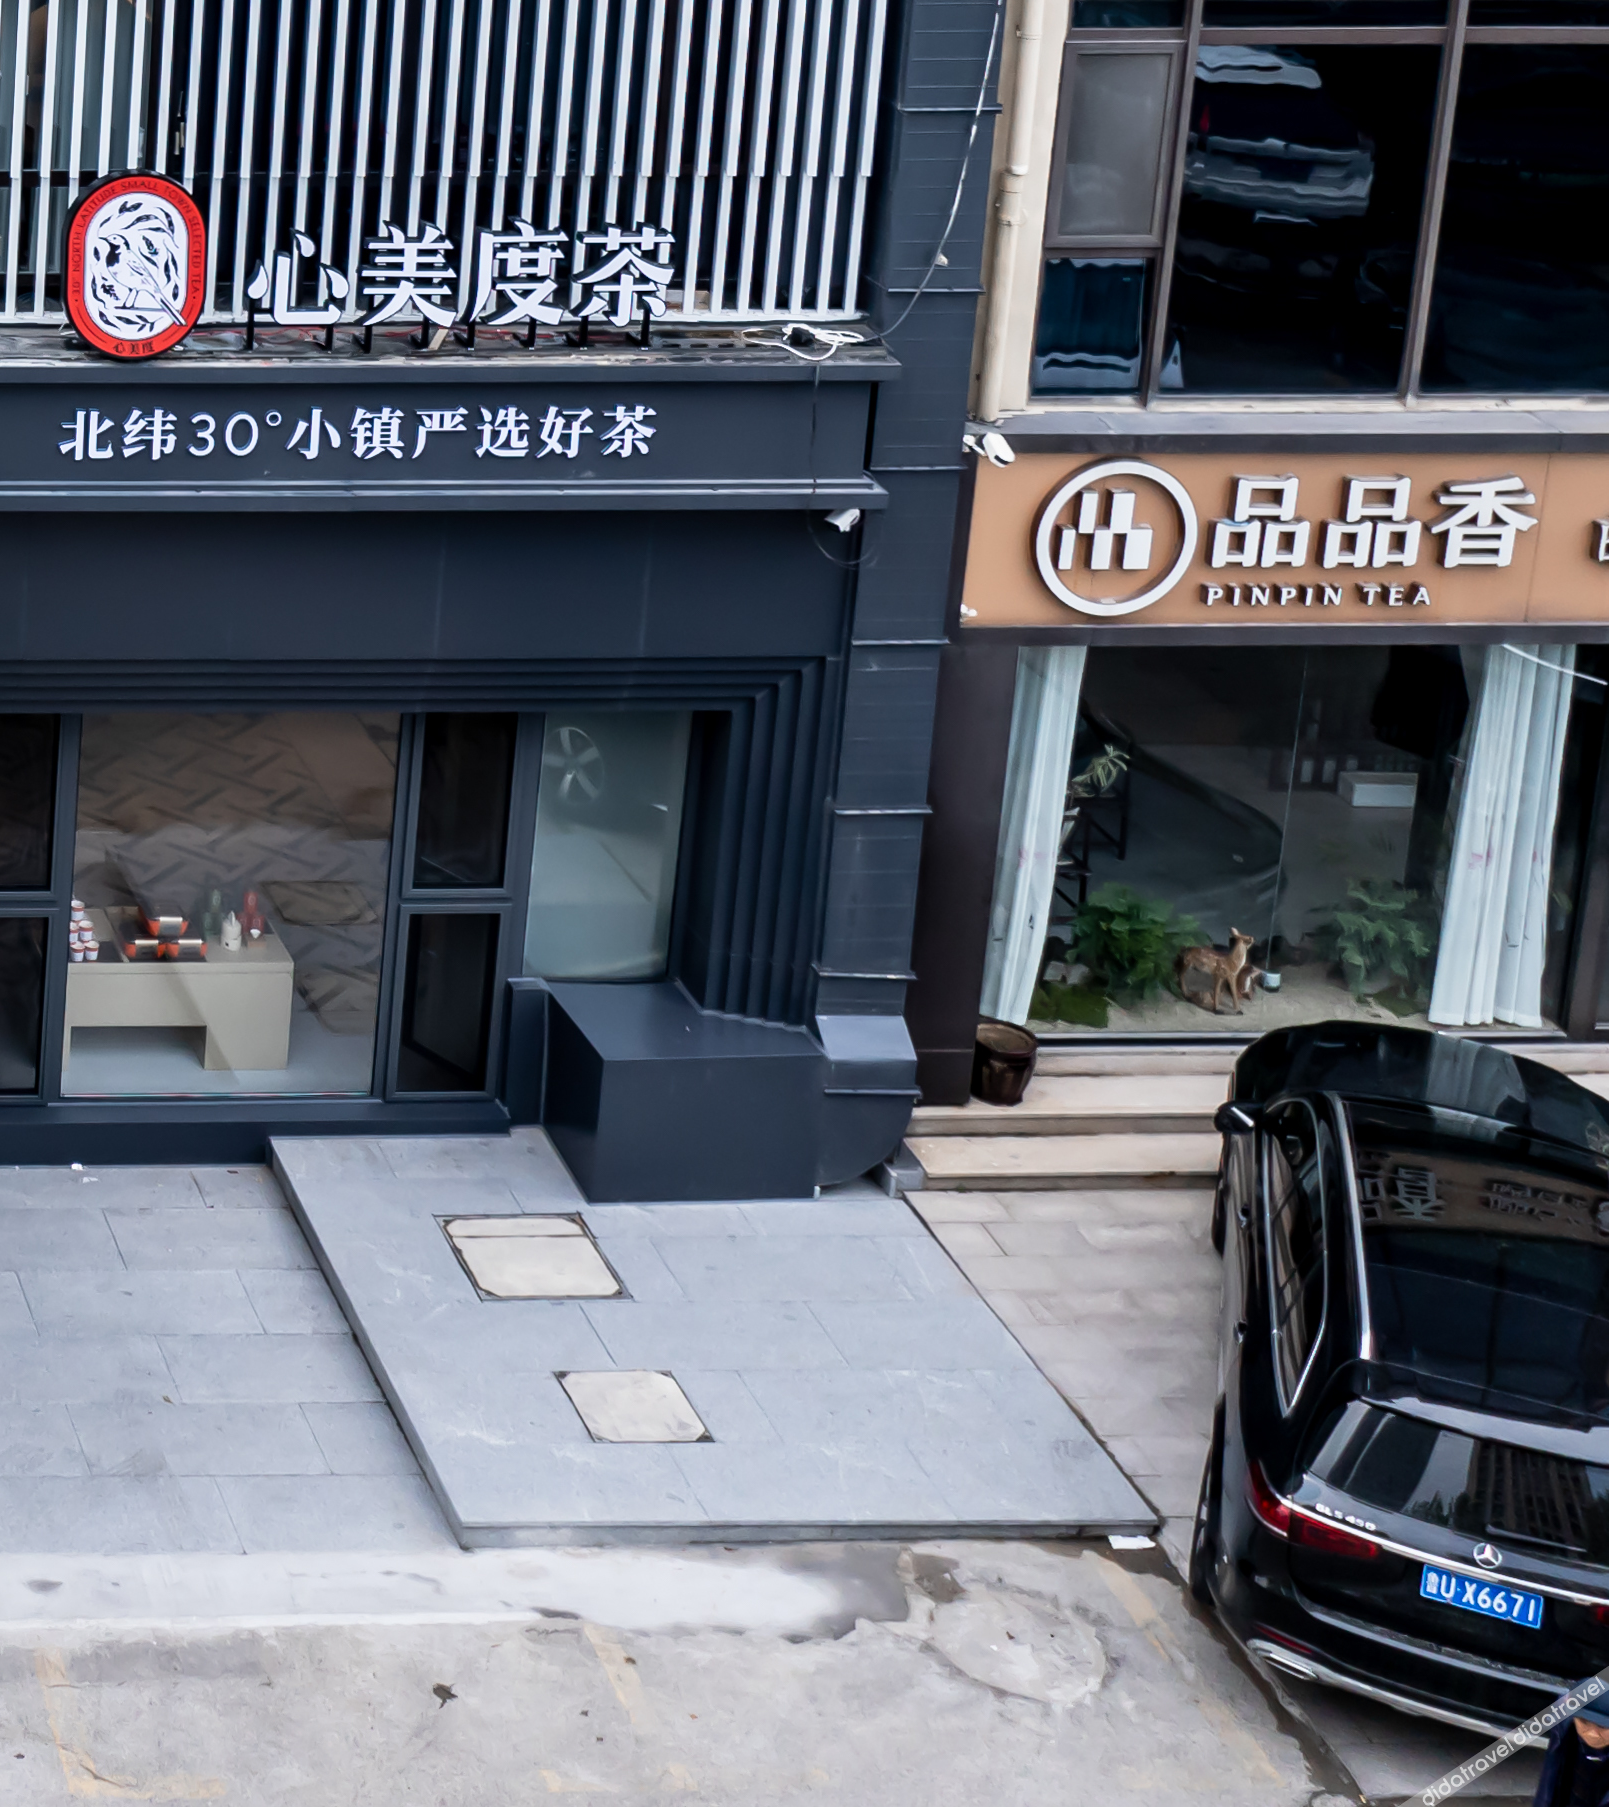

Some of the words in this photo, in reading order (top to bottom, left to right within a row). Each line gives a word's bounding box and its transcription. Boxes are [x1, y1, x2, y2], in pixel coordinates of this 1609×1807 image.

[121, 180, 159, 191] SMALL
[246, 216, 676, 328] 心美度茶
[1209, 475, 1539, 569] 品品香
[1205, 585, 1343, 607] PINPIN
[1361, 585, 1432, 607] TEA
